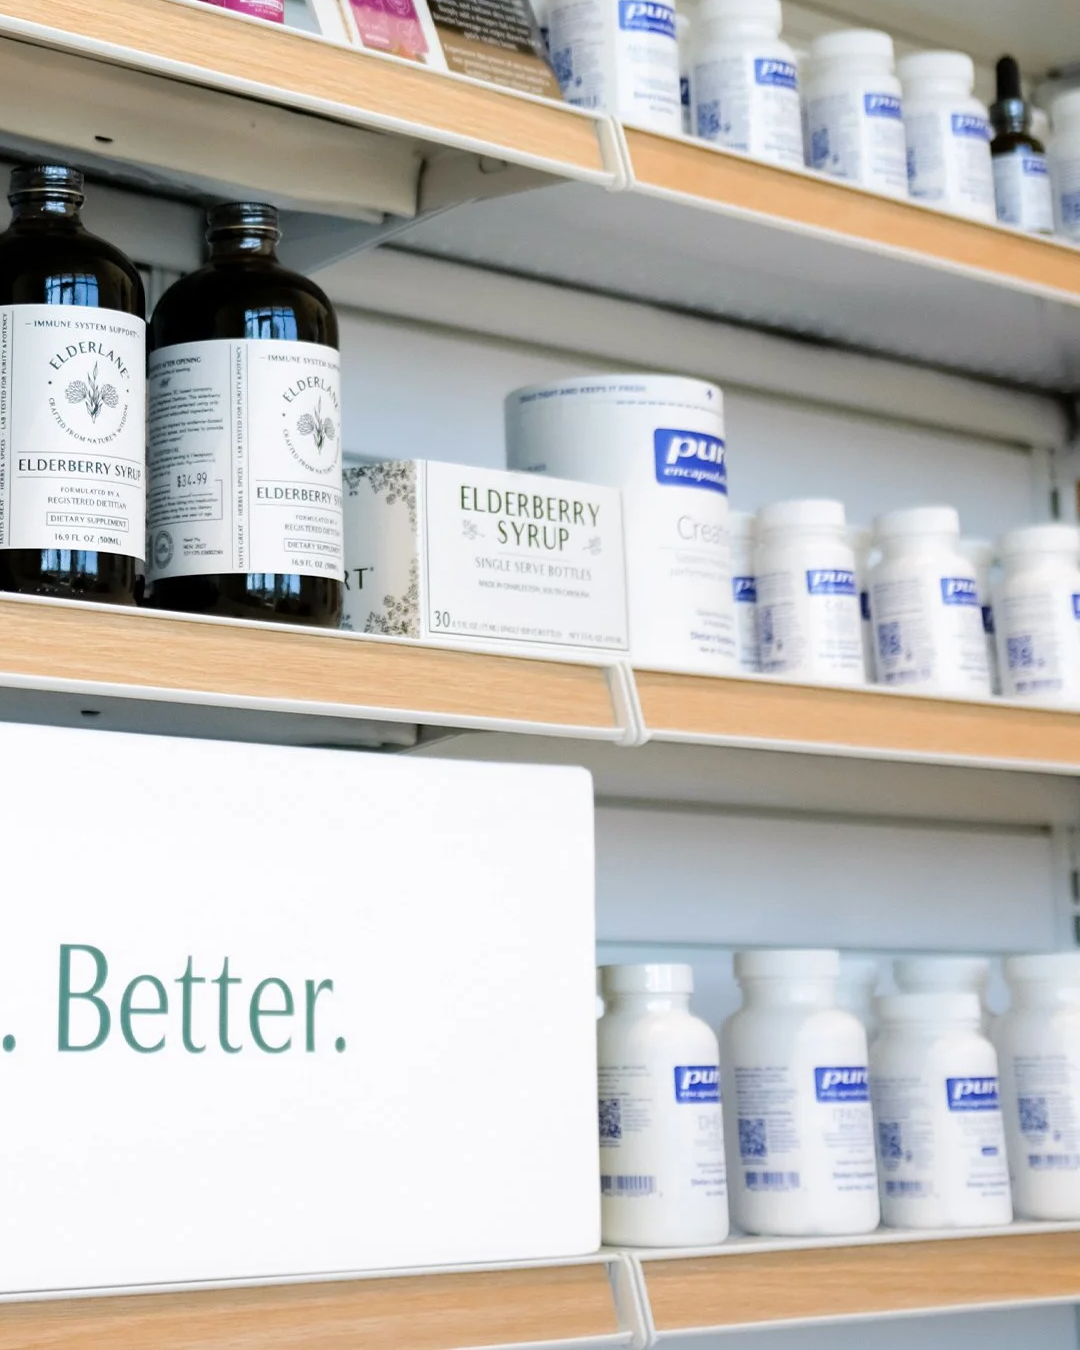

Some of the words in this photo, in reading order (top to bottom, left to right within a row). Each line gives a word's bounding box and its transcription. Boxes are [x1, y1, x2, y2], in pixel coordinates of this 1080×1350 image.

[34, 320, 71, 328] IMMUNE
[75, 322, 107, 331] SYSTEM
[109, 326, 136, 337] SUPPORT
[49, 341, 129, 379] ELDERLANE
[267, 354, 301, 364] IMMUNE
[18, 459, 111, 475] ELDERBERRY
[115, 464, 141, 482] SYRUP
[176, 472, 207, 488] $34.99
[47, 497, 95, 506] REGISTERED
[96, 499, 127, 510] DIETITIAN
[256, 487, 332, 504] ELDERBERRY
[460, 485, 600, 527] ELDERBERRY
[87, 517, 126, 527] SUPPLEMENT
[72, 533, 80, 541] FL
[83, 535, 95, 543] OZ
[497, 520, 569, 551] SYRUP
[287, 541, 315, 549] DIETARY
[475, 557, 511, 572] SINGLE
[514, 561, 545, 576] SERVE
[548, 564, 592, 581] BOTTLES
[434, 610, 451, 628] 30
[56, 942, 346, 1054] Better.
